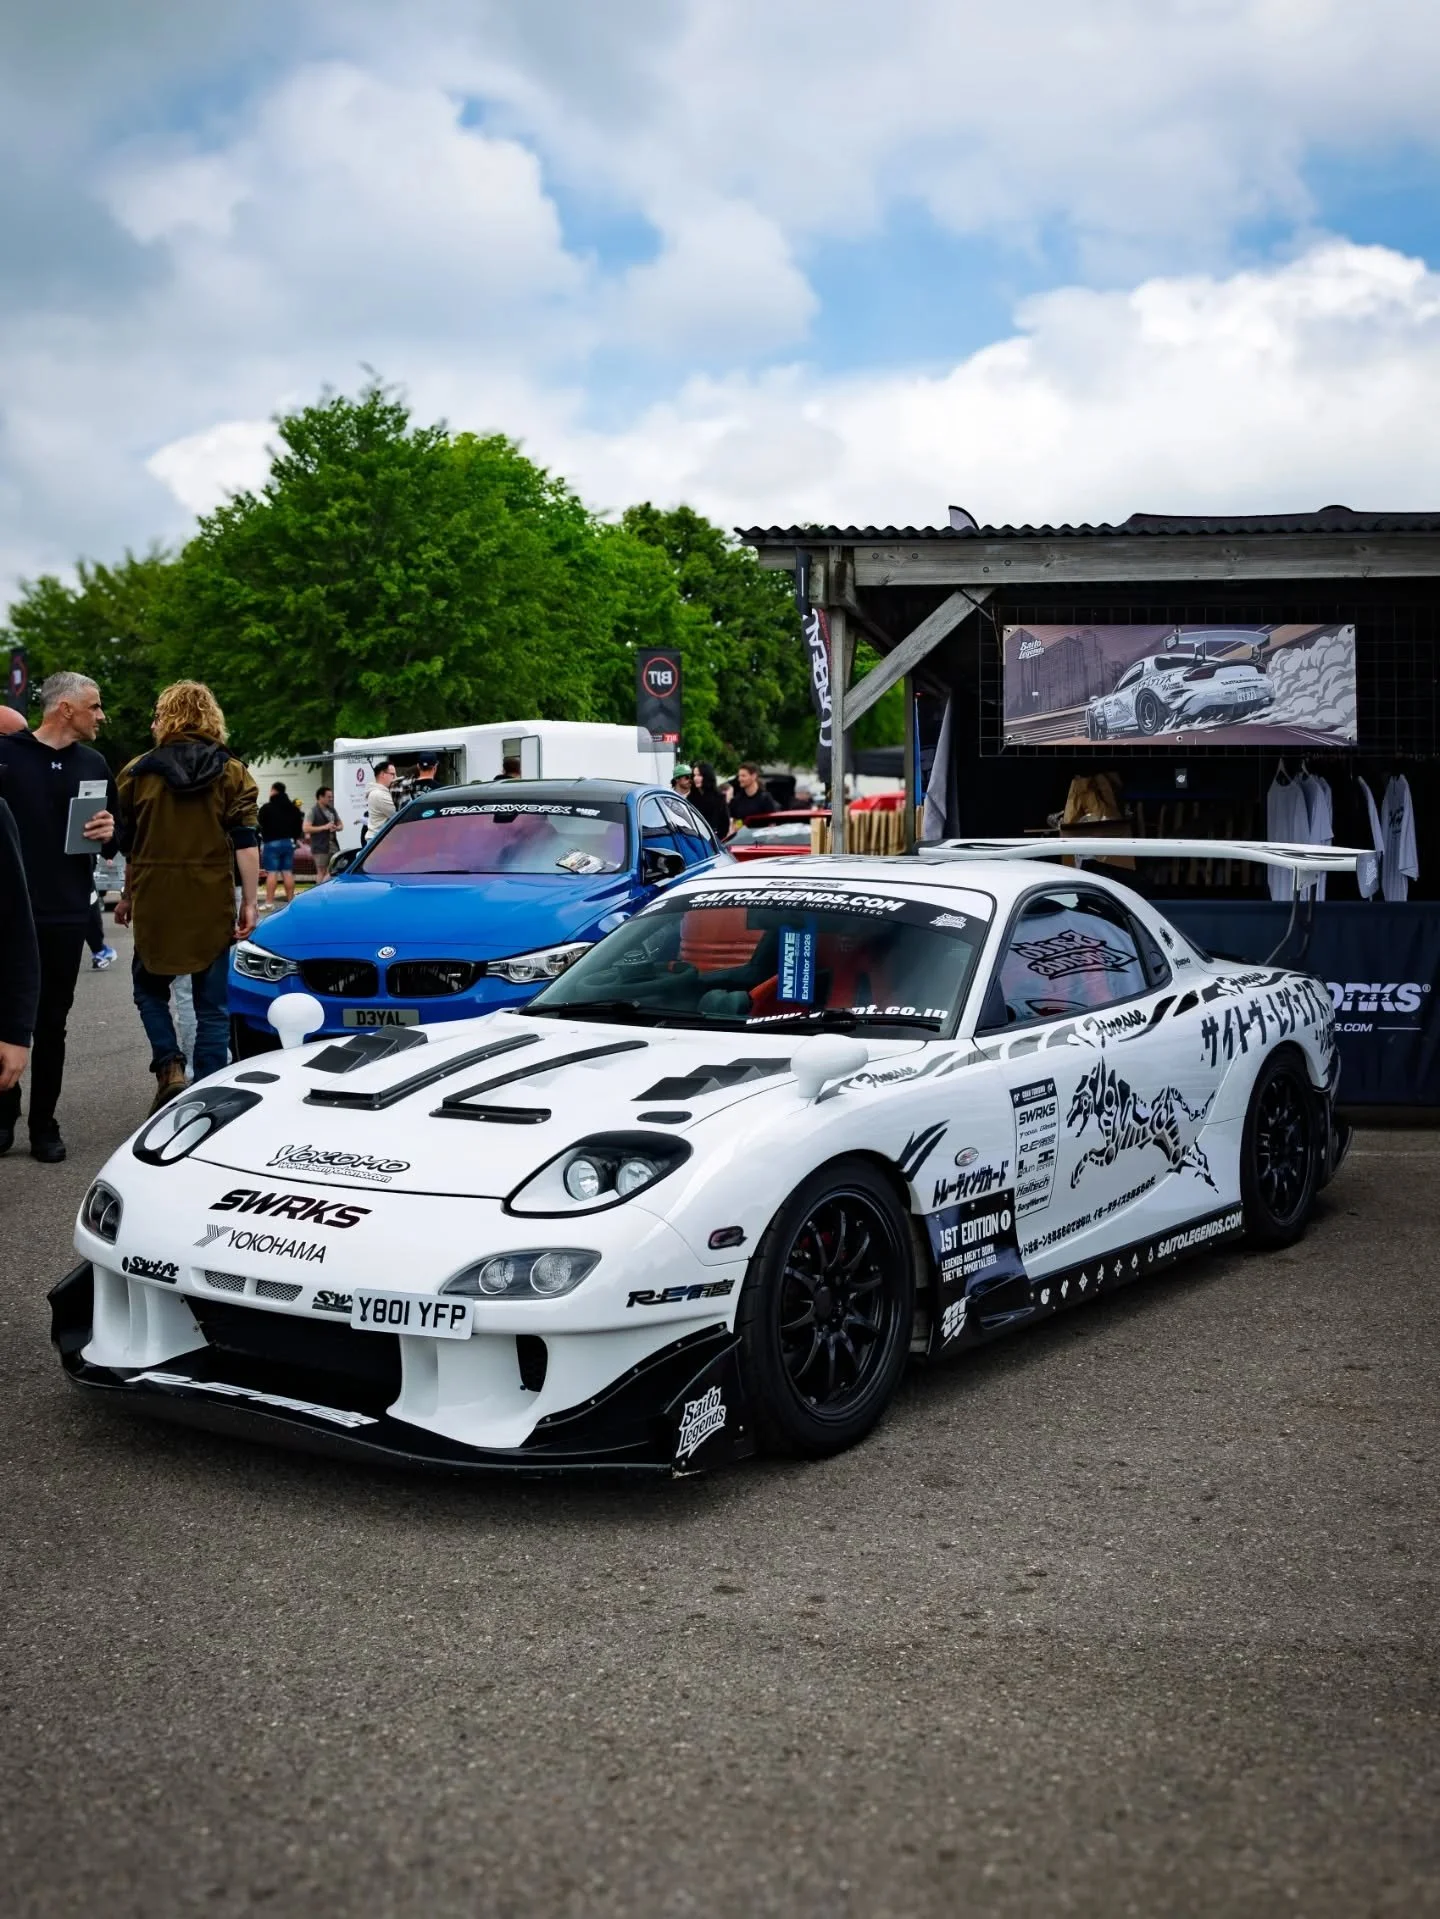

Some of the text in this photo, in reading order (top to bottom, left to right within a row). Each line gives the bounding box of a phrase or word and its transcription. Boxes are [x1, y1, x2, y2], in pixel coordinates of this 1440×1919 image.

[440, 804, 573, 815] TRACKWORX
[688, 890, 906, 912] SAITOLEGENDS.COM
[782, 932, 796, 999] INITIATE
[802, 959, 810, 1000] Exhibitor
[356, 1010, 406, 1026] D3YAL
[1018, 1102, 1056, 1126] SWRKS
[1016, 1176, 1050, 1197] Haltech
[208, 1189, 374, 1229] SWRKS
[227, 1229, 327, 1264] YOKOHAMA
[940, 1225, 959, 1253] 1ST
[961, 1212, 999, 1246] EDITION
[1157, 1210, 1243, 1259] SAITOLEGENDS.COM
[941, 1254, 963, 1271] LEGENDS
[418, 1301, 467, 1329] YFP
[682, 1387, 722, 1429] Saito
[677, 1405, 726, 1454] Legends
